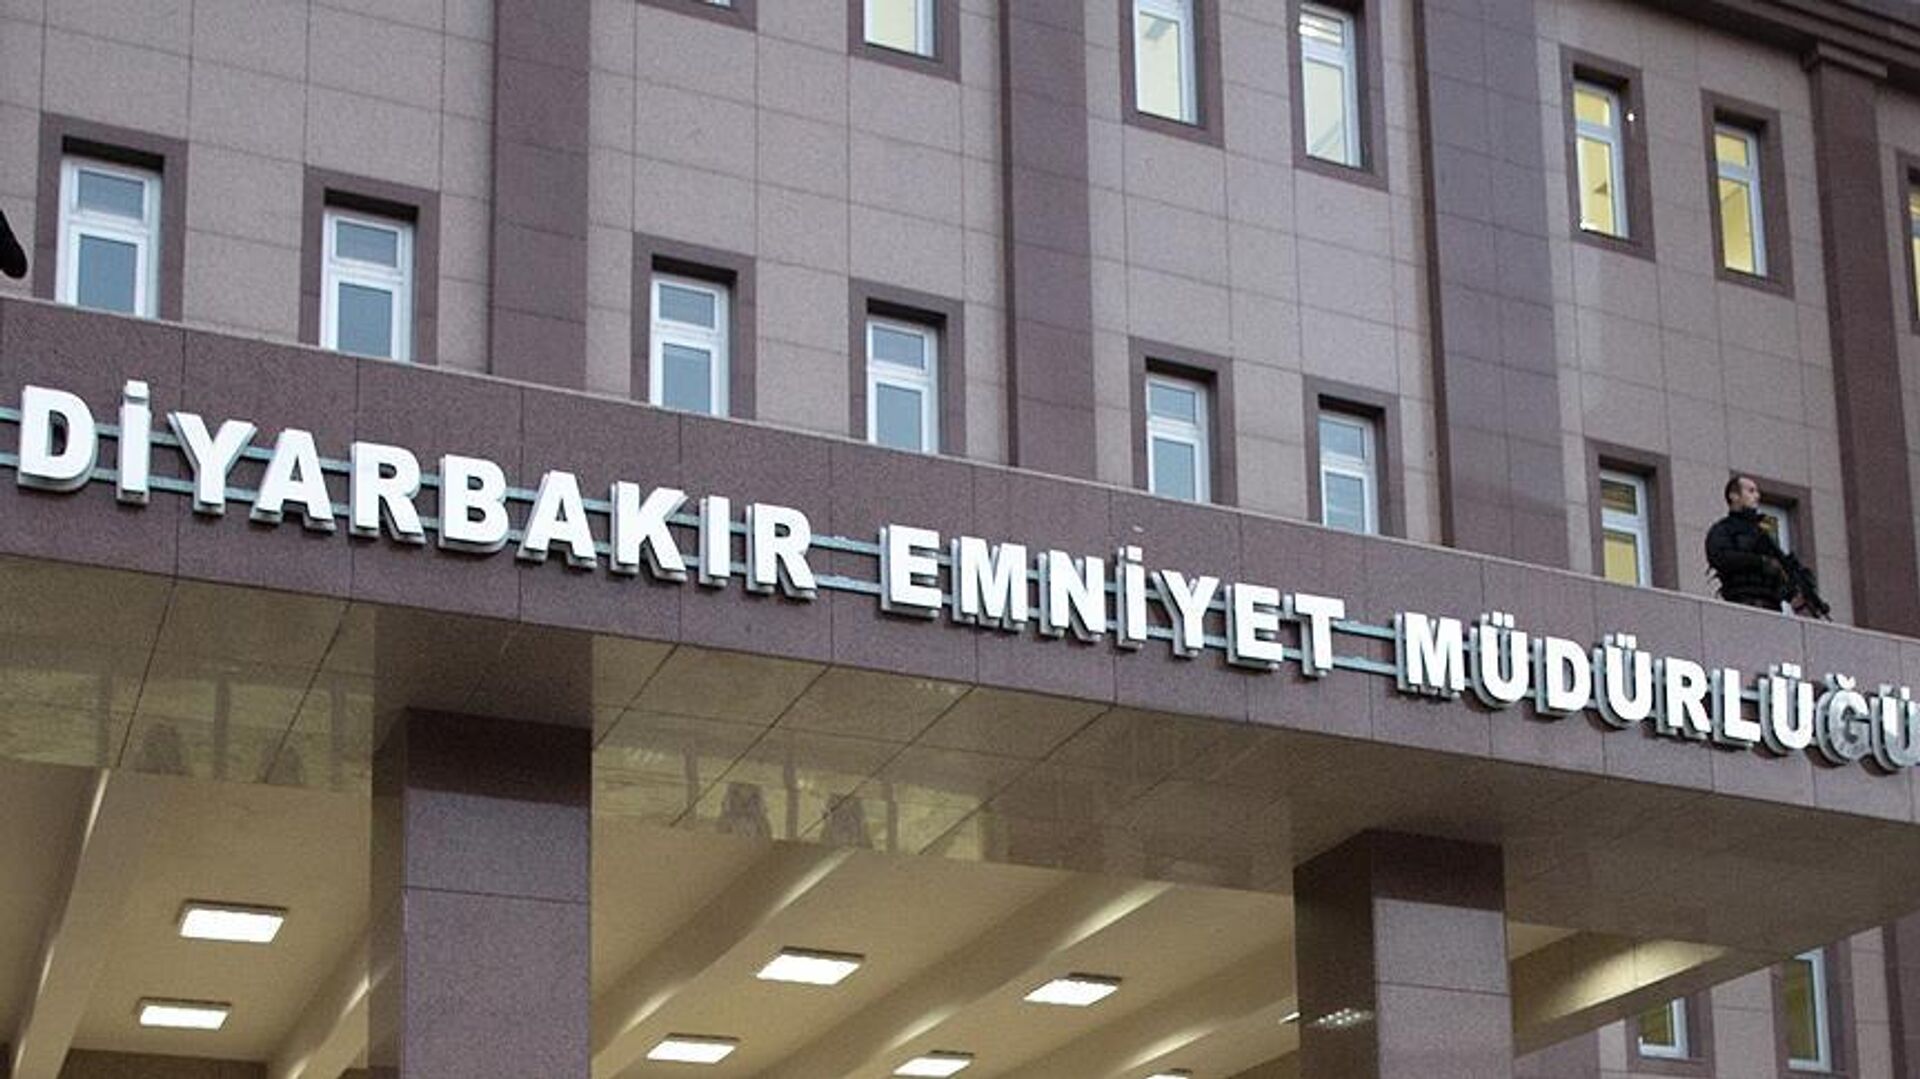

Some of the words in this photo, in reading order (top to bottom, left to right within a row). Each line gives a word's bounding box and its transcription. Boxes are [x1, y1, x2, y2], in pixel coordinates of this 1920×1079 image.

[18, 380, 816, 599] DİYARBAKIR
[880, 524, 1346, 677] EMNİYET
[1395, 611, 1920, 771] MÜDÜRLÜĞÜ
